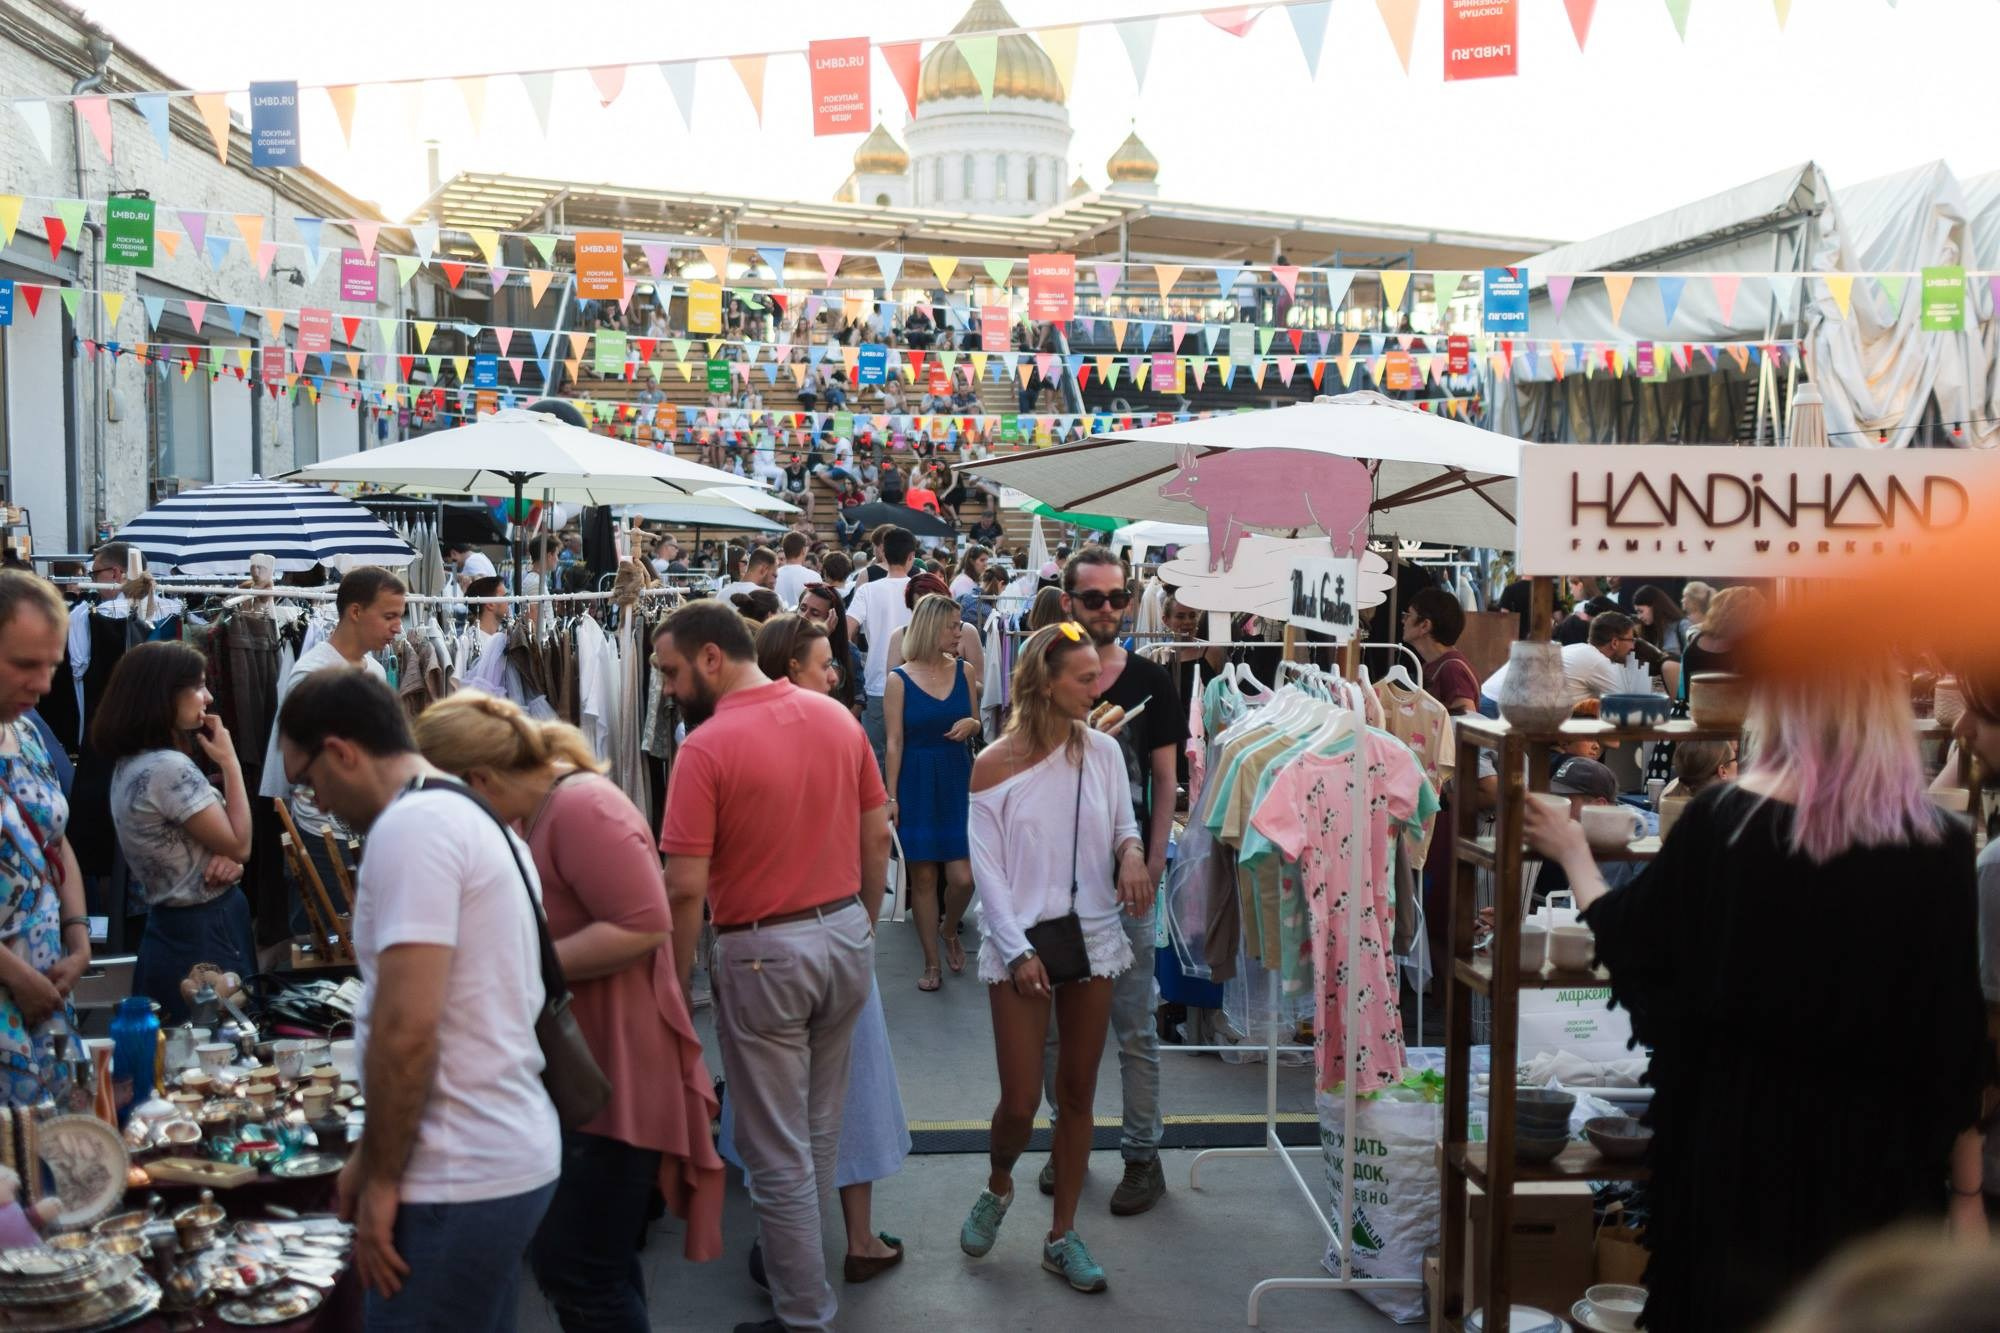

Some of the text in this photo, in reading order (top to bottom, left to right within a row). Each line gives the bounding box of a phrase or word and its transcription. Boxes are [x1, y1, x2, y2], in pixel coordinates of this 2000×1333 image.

[1459, 7, 1504, 20] ПОКУПАЙ
[1452, 45, 1512, 61] LMBD.RU
[816, 56, 864, 70] LMBD.RU
[255, 96, 295, 106] LMBD.RU
[824, 92, 860, 103] ПОКУПАЙ
[819, 102, 864, 112] ОСОБЕННЫЕ
[832, 113, 852, 122] ВЕЩИ
[112, 211, 150, 220] LMBD.RU
[581, 245, 618, 253] LMBD.RU
[1033, 267, 1070, 276] LMBD.RU
[1488, 312, 1524, 320] LMBD.RU
[1572, 539, 1715, 552] FAMILY
[1356, 1206, 1385, 1250] MERLIN
